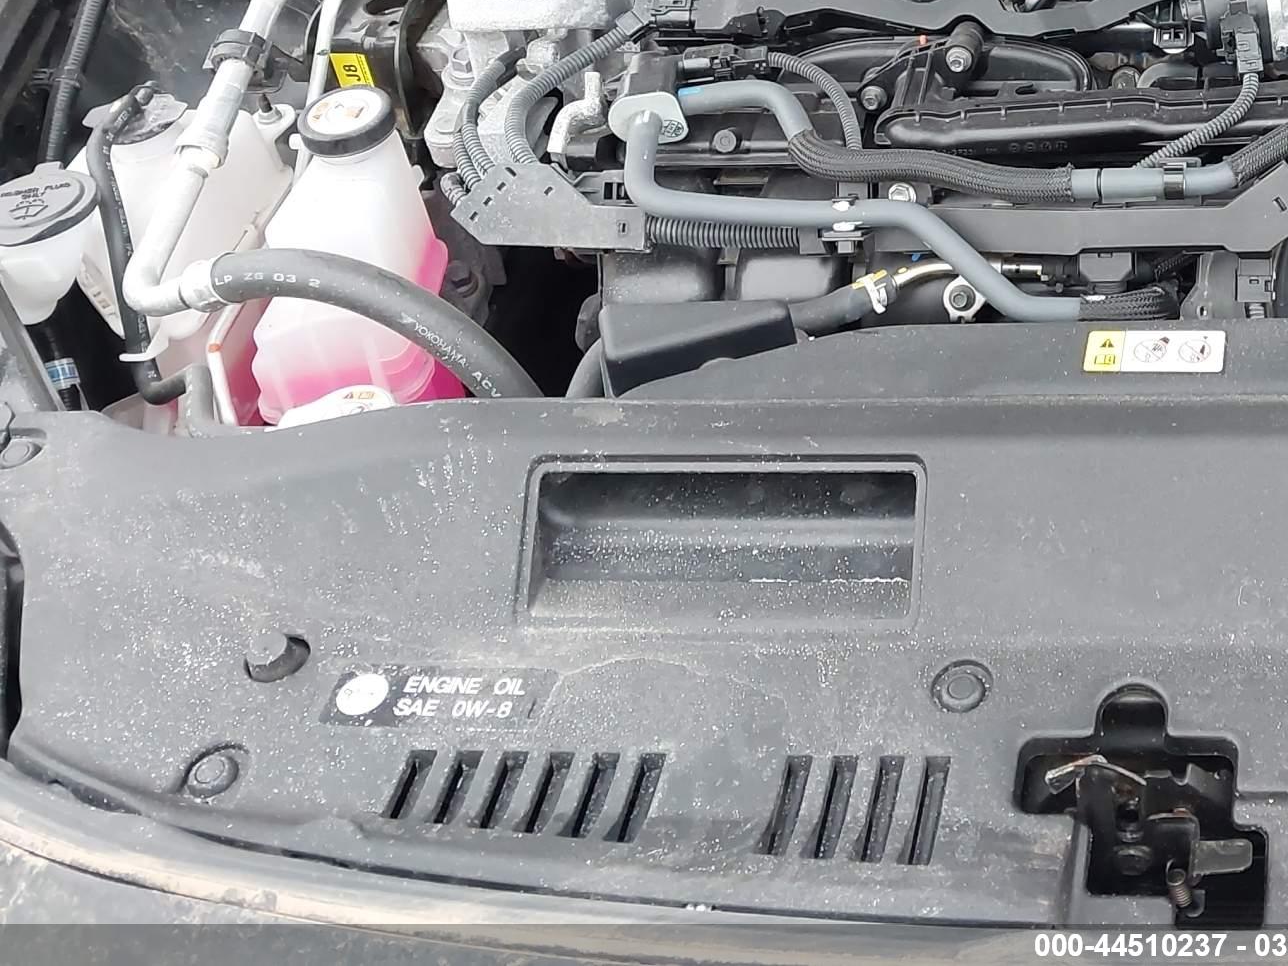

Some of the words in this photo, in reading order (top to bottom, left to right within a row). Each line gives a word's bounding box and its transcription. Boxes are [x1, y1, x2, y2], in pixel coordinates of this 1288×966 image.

[414, 322, 468, 368] YOKOHAMA
[402, 675, 483, 695] ENGINE
[492, 677, 525, 696] OIL
[392, 698, 440, 717] SAE
[451, 700, 513, 718] 0W-8
